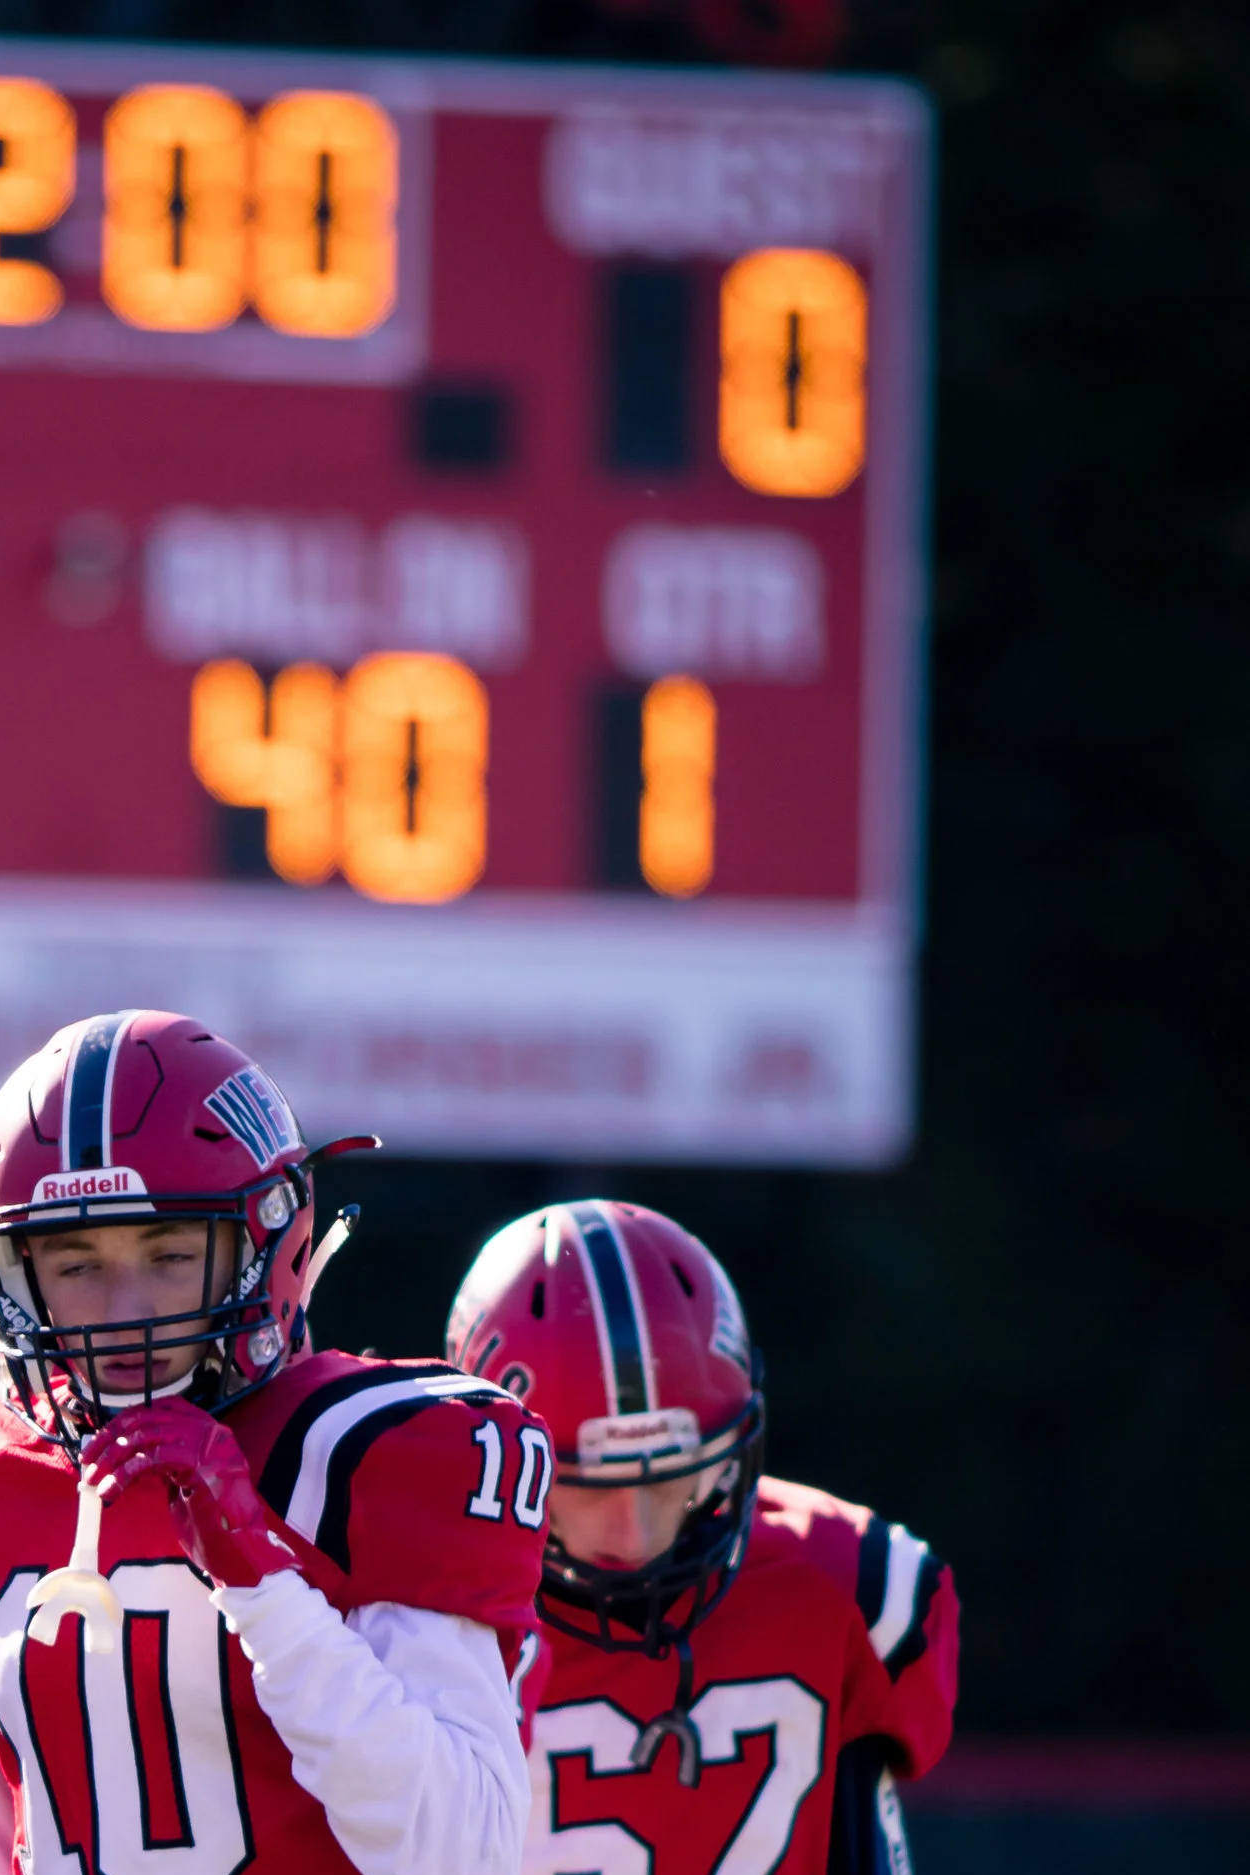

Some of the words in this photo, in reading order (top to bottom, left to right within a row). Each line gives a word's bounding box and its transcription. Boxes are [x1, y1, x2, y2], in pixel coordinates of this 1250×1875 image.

[717, 246, 868, 498] 0
[188, 650, 490, 904] 40
[639, 675, 717, 898] 1
[43, 1172, 128, 1200] Riddell
[464, 1417, 554, 1533] 10
